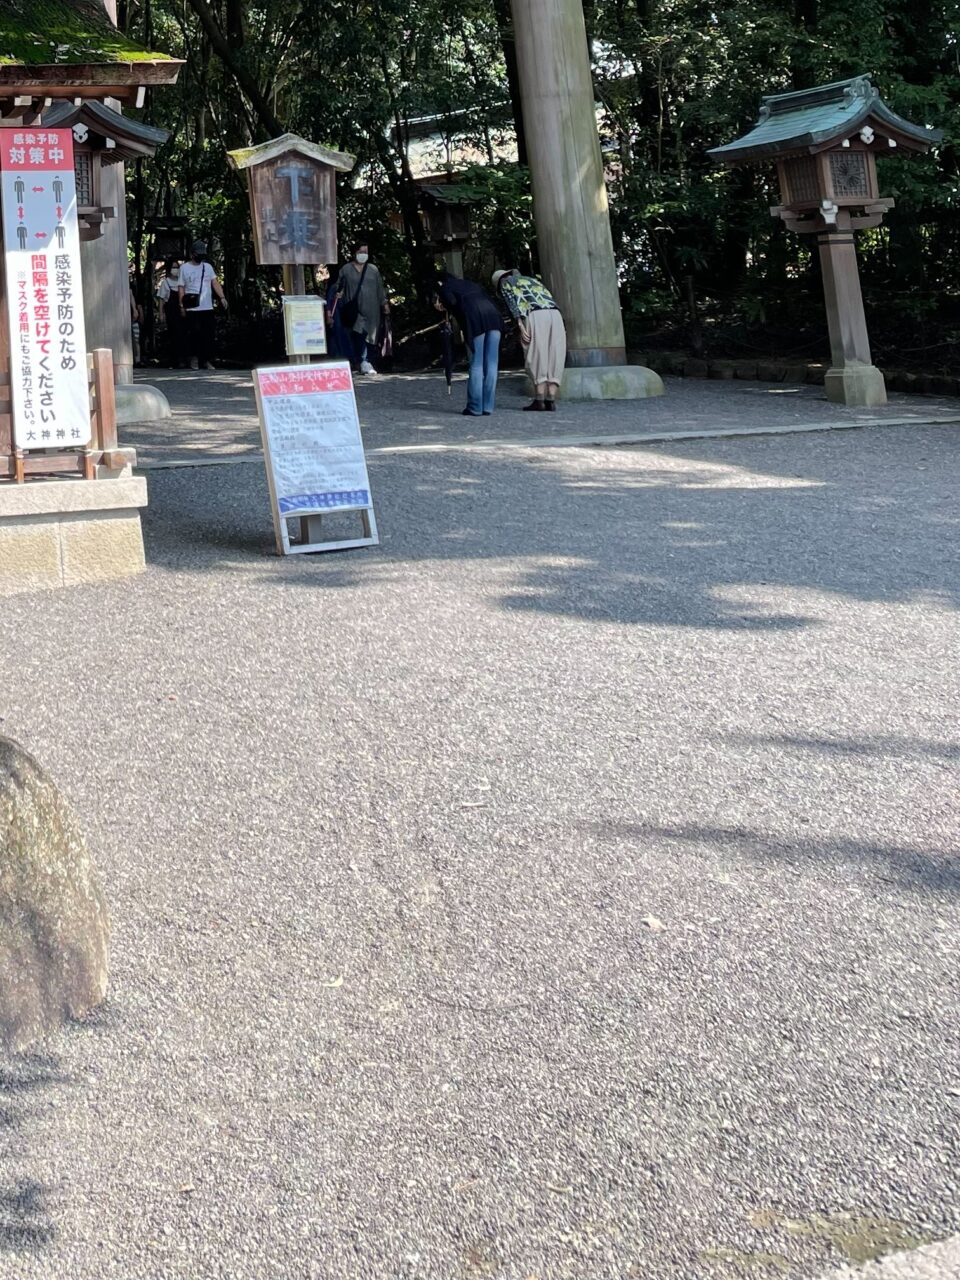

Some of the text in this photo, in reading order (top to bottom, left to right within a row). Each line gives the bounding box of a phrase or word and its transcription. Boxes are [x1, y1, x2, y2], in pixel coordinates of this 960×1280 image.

[13, 133, 59, 145] 感染予防
[9, 147, 64, 164] 対策中
[54, 253, 77, 371] 感染予防のため
[31, 254, 56, 423] 間隔を空けてください
[26, 427, 81, 441] 大神神社
